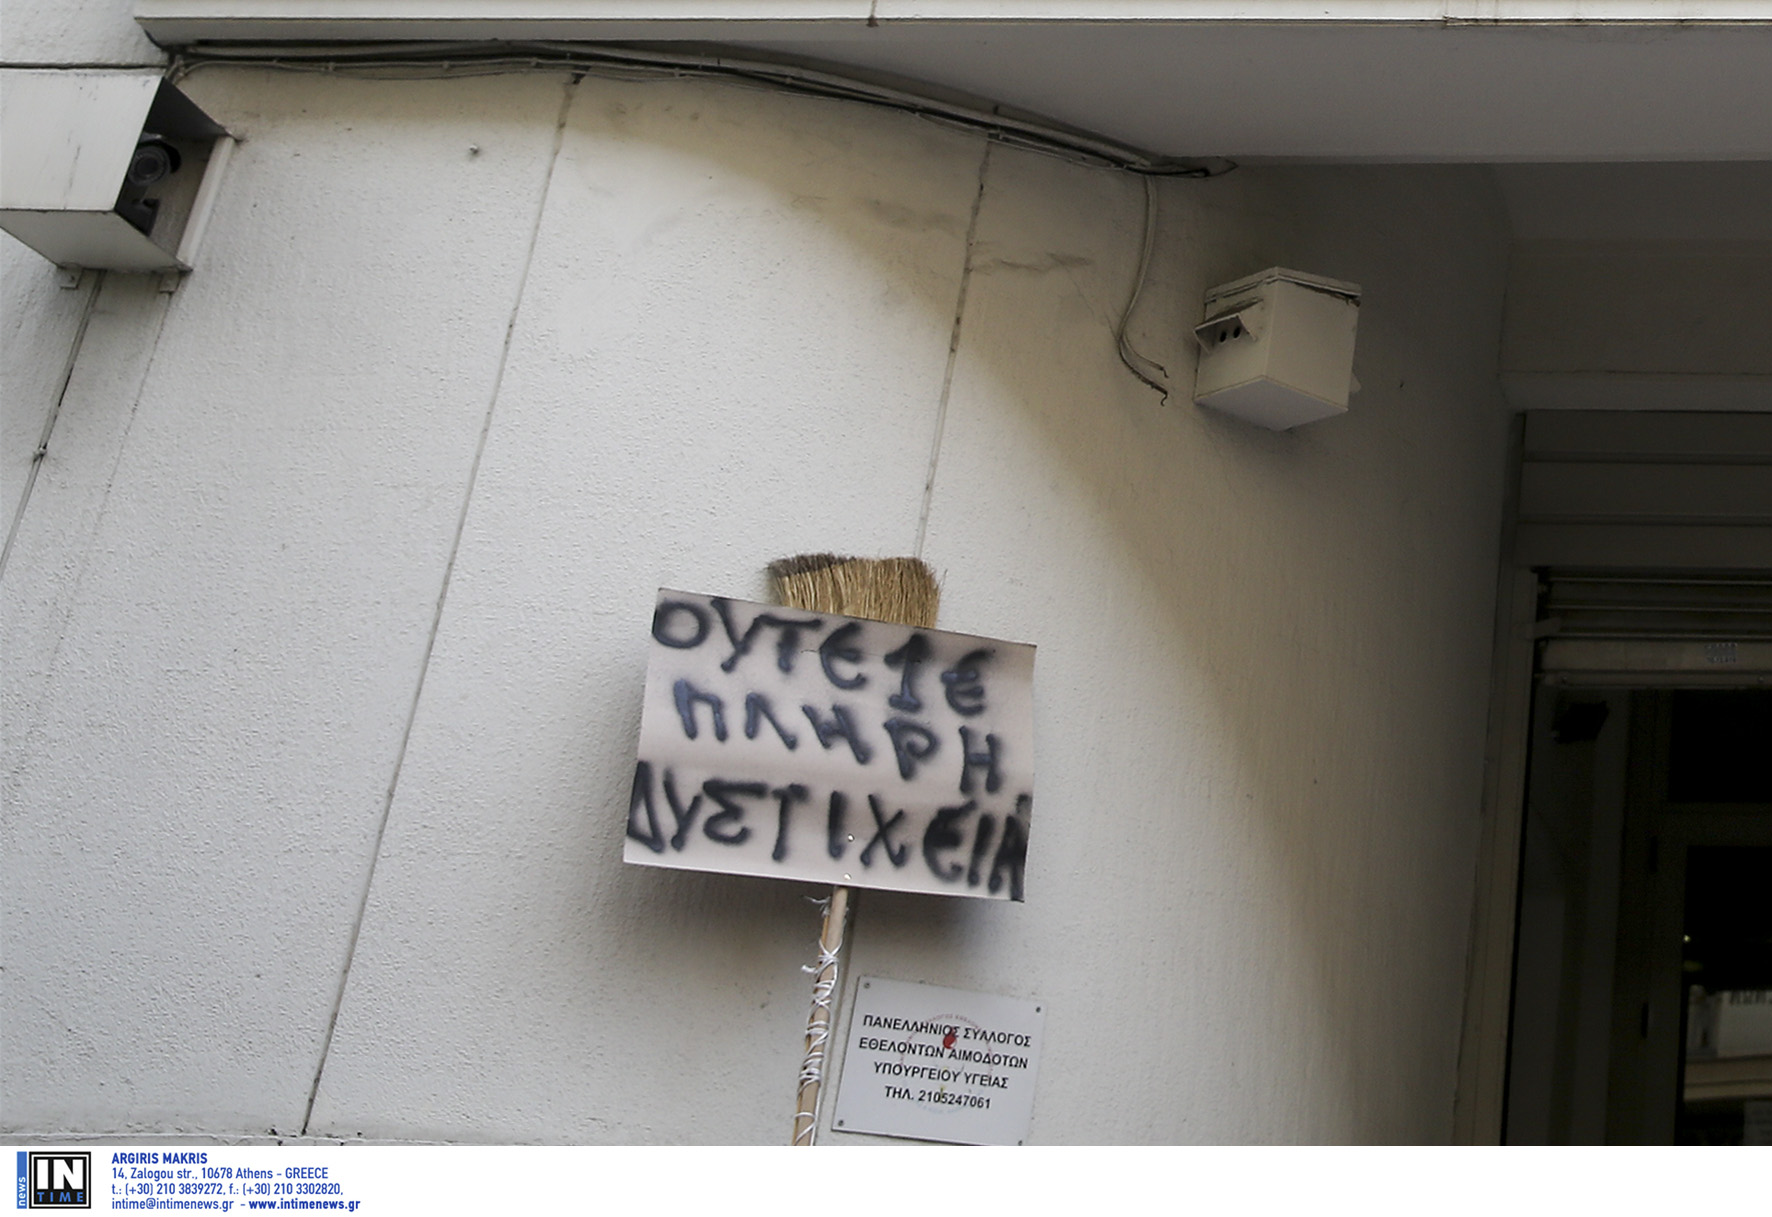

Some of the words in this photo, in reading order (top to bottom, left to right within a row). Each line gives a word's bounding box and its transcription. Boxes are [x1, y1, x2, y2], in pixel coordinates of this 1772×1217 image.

[673, 678, 1011, 794] ΠΛΗΡΗ
[863, 1014, 960, 1038] ΠΑΝΕΛΛΗΝΙΟΣ
[964, 1027, 1032, 1047] ΣΥΛΛΟΓΟΣ
[859, 1037, 945, 1058] ΕΘΕΛΟΝΤΩΝ
[948, 1048, 1029, 1069] ΑΙΜΟΔΟΤΩΝ
[874, 1062, 961, 1083] ΥΠΟΥΡΓΕΙΟΥ
[965, 1072, 1009, 1089] ΥΓΕΙΑΣ
[885, 1085, 914, 1101] ΤΗΛ.
[918, 1090, 991, 1109] 2105247061
